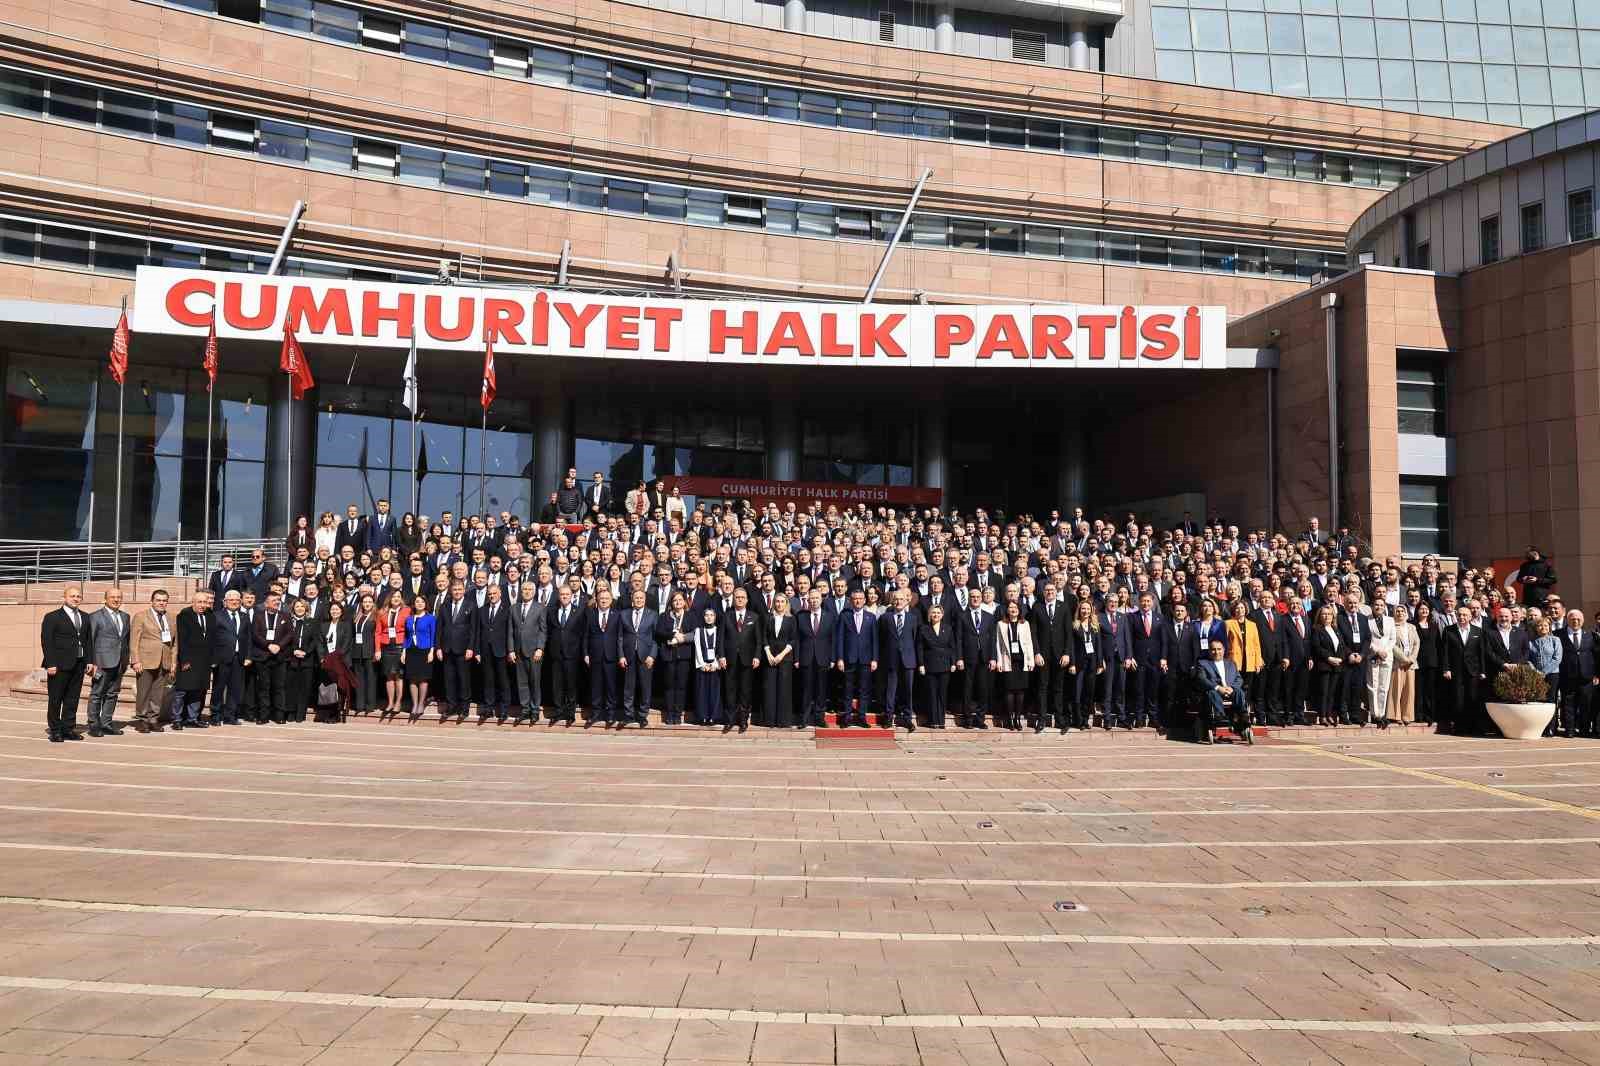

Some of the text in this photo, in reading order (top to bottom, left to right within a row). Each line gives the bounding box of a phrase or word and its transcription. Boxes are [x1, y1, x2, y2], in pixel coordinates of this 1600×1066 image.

[166, 278, 1202, 361] CUMHURİYET HALK PARTİSİ
[721, 483, 888, 500] CUMHURİYET HALK PARTİSİ
